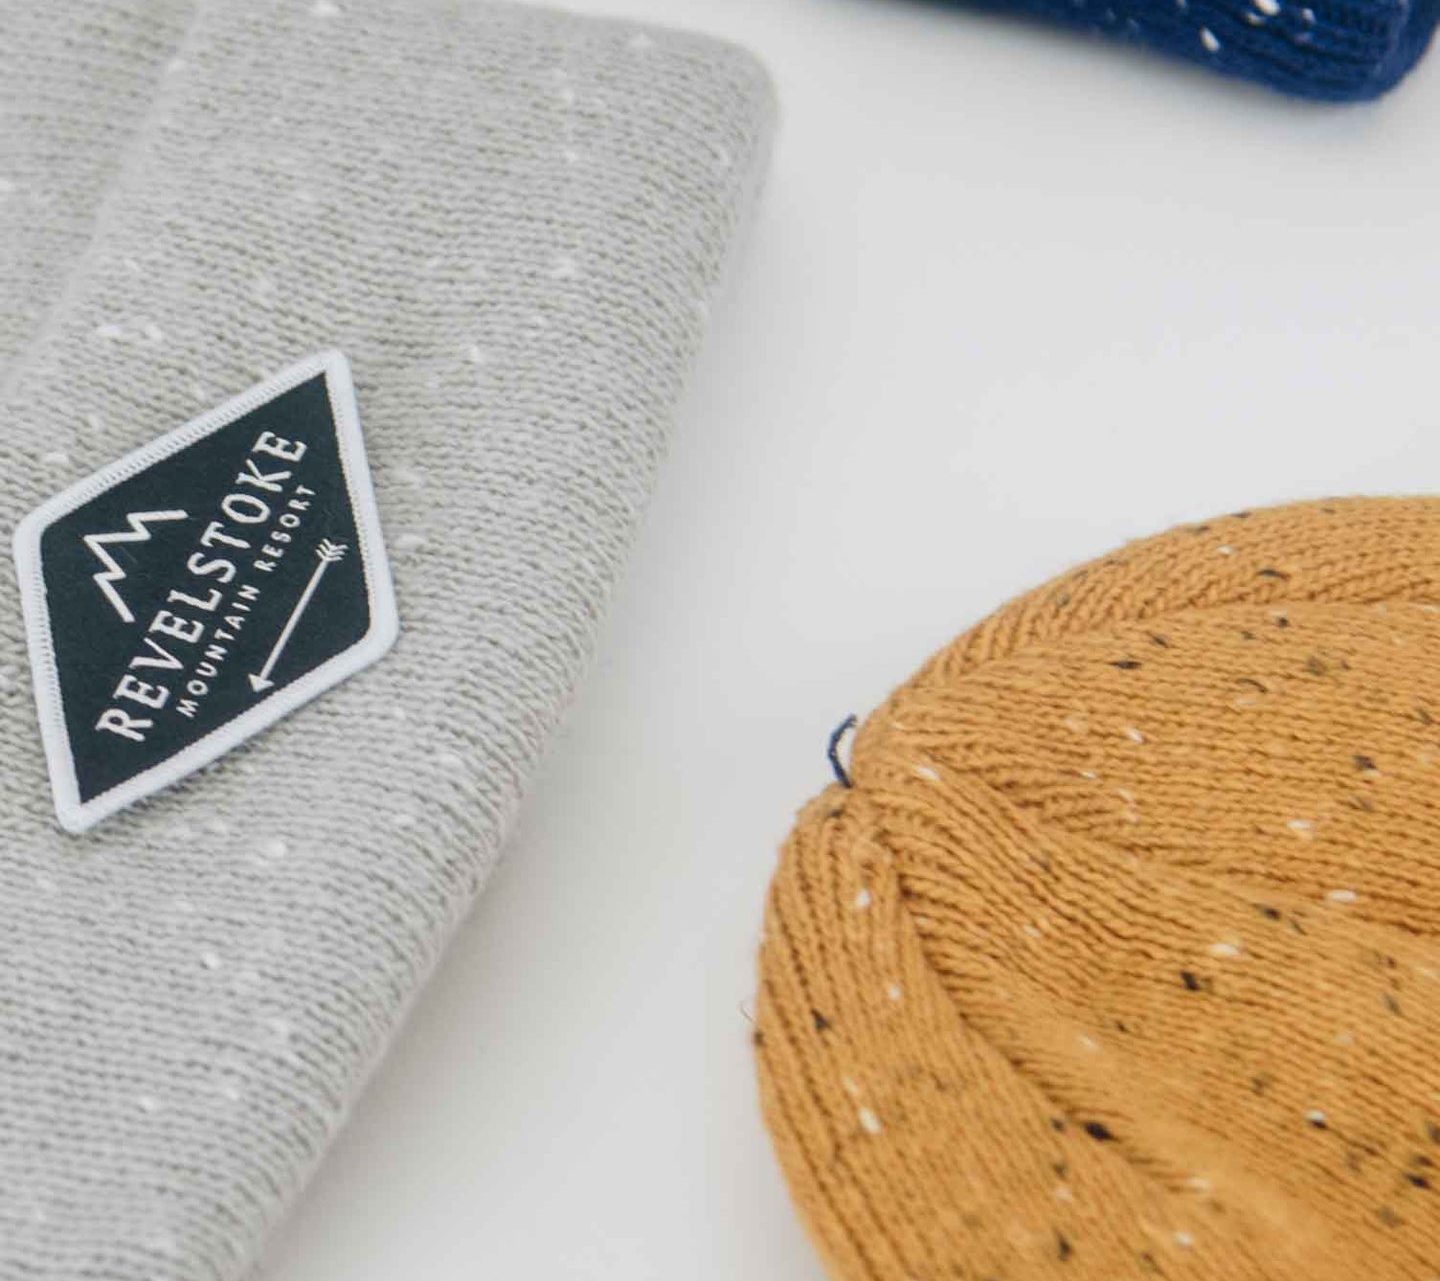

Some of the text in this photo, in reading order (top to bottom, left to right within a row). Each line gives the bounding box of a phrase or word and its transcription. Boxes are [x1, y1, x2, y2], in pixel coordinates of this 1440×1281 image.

[94, 430, 308, 743] REVELSTOKE
[176, 485, 316, 718] MOUNTAIN RESORT
